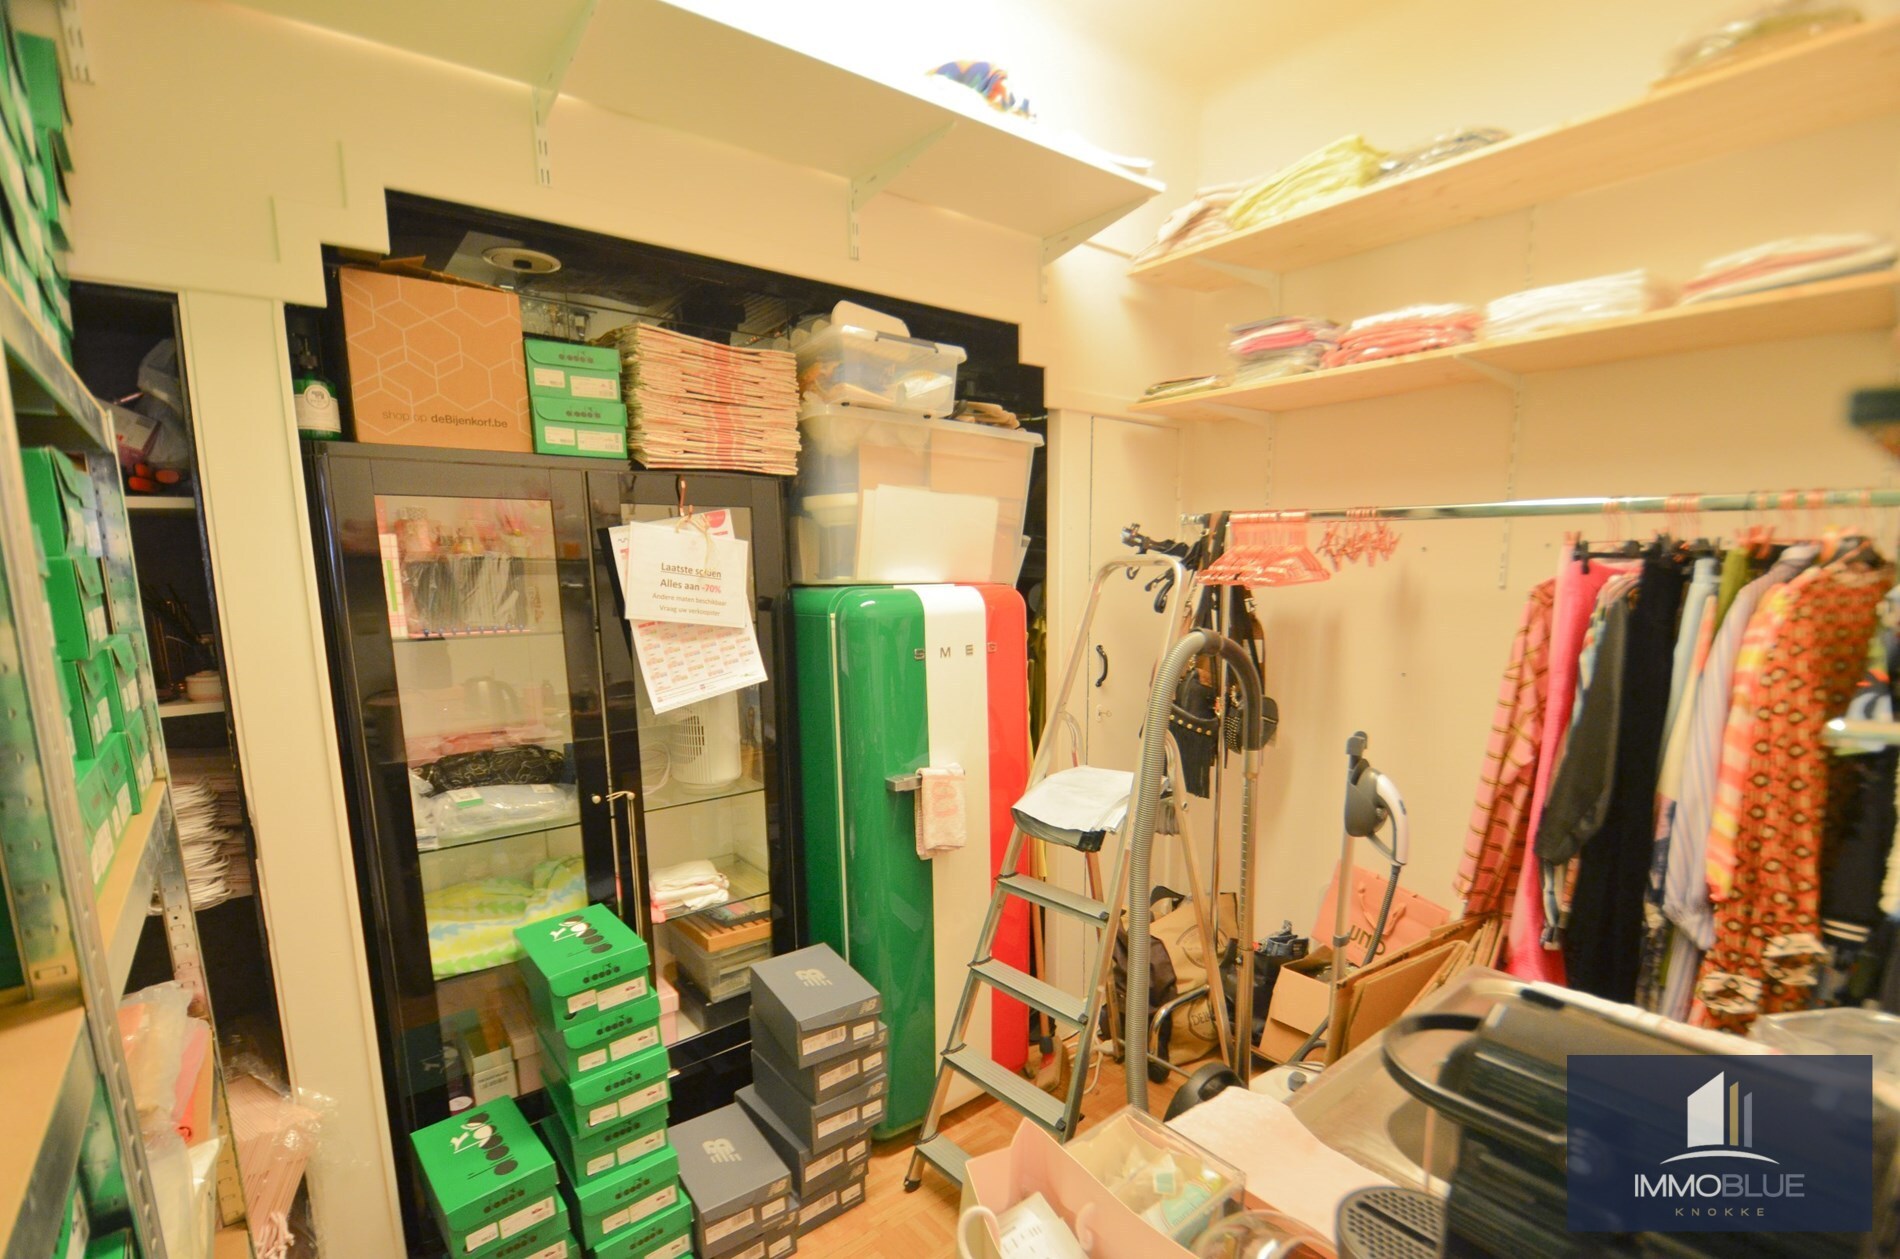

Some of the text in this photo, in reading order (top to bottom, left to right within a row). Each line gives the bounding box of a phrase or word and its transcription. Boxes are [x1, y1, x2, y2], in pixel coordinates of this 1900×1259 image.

[430, 413, 508, 429] deBijenkorf.be
[661, 562, 693, 575] Laatste
[660, 578, 722, 594] Alles aan -70%
[652, 592, 675, 601] Andere
[659, 604, 677, 614] Vraag
